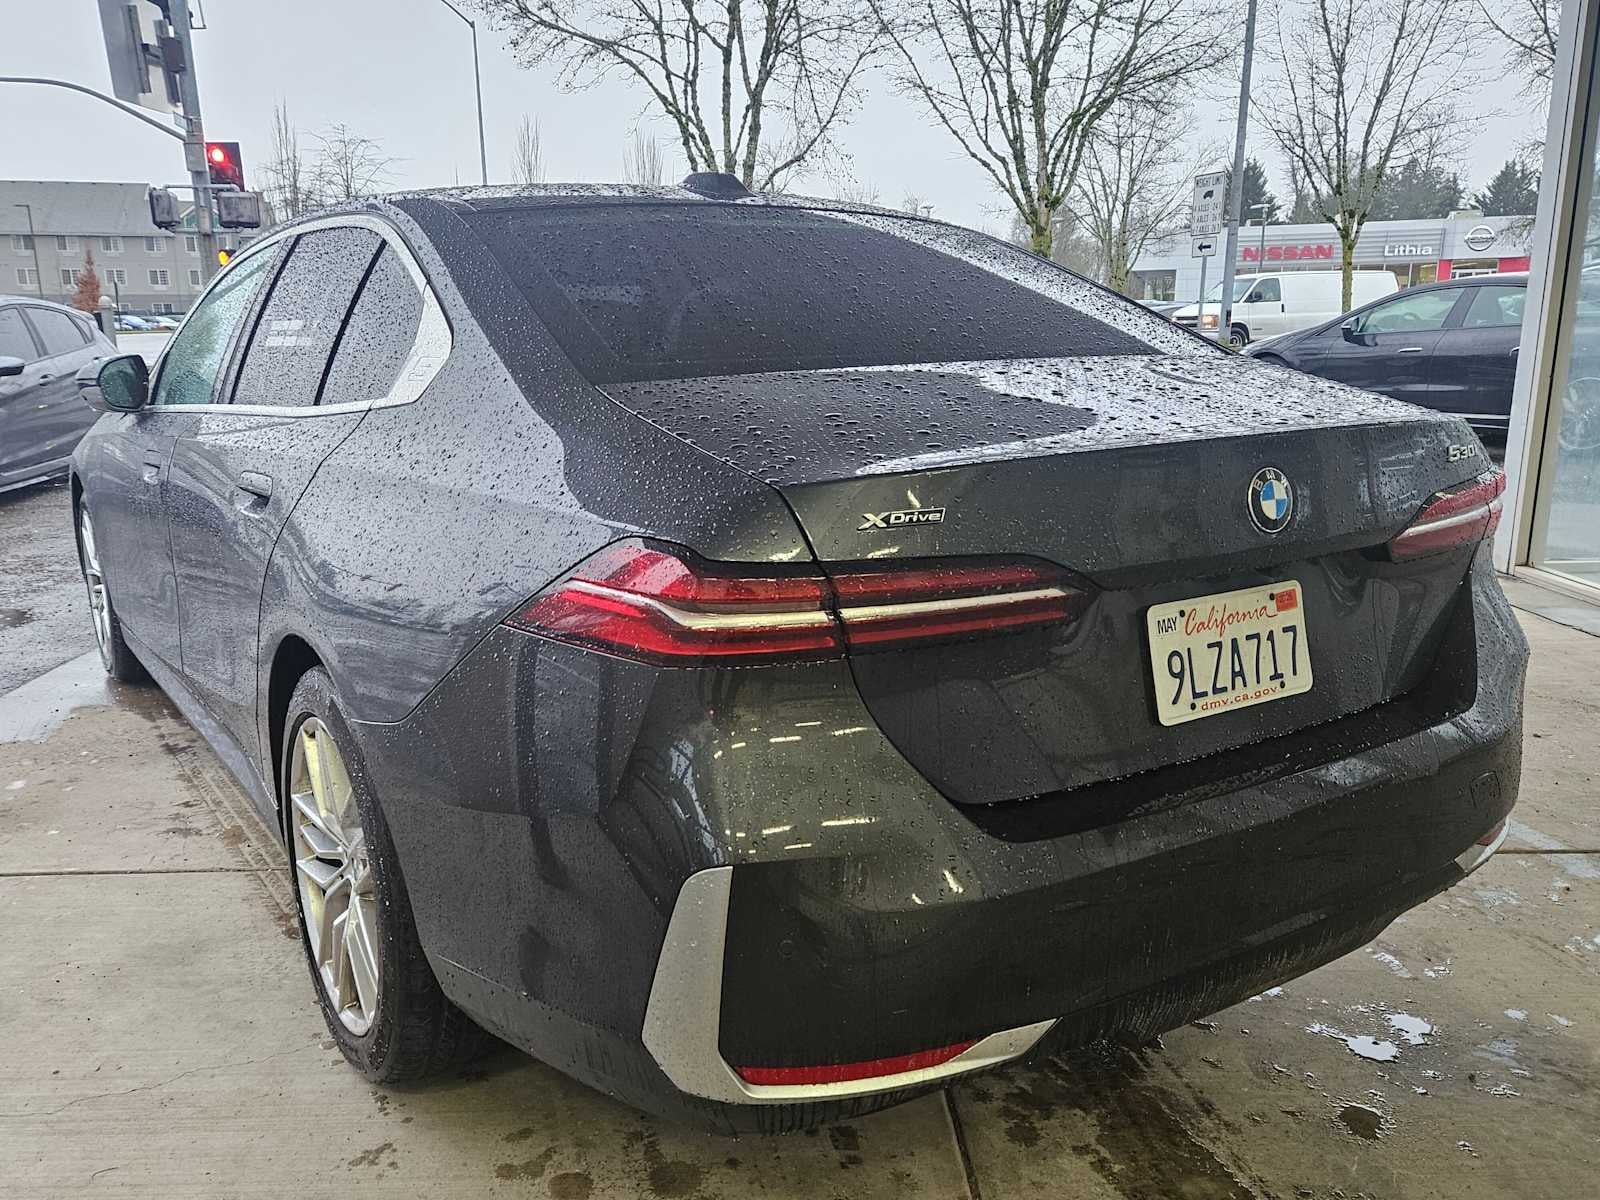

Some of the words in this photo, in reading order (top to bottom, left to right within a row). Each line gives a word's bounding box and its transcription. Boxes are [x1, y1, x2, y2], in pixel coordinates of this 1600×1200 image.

[1242, 245, 1334, 261] NSSAN
[1383, 244, 1433, 257] Lithia
[1253, 469, 1288, 491] BMW
[1157, 616, 1177, 635] MAY
[1184, 600, 1277, 638] California
[1167, 625, 1297, 705] 9LZA717
[1201, 685, 1278, 711] dmv.ca.gov
